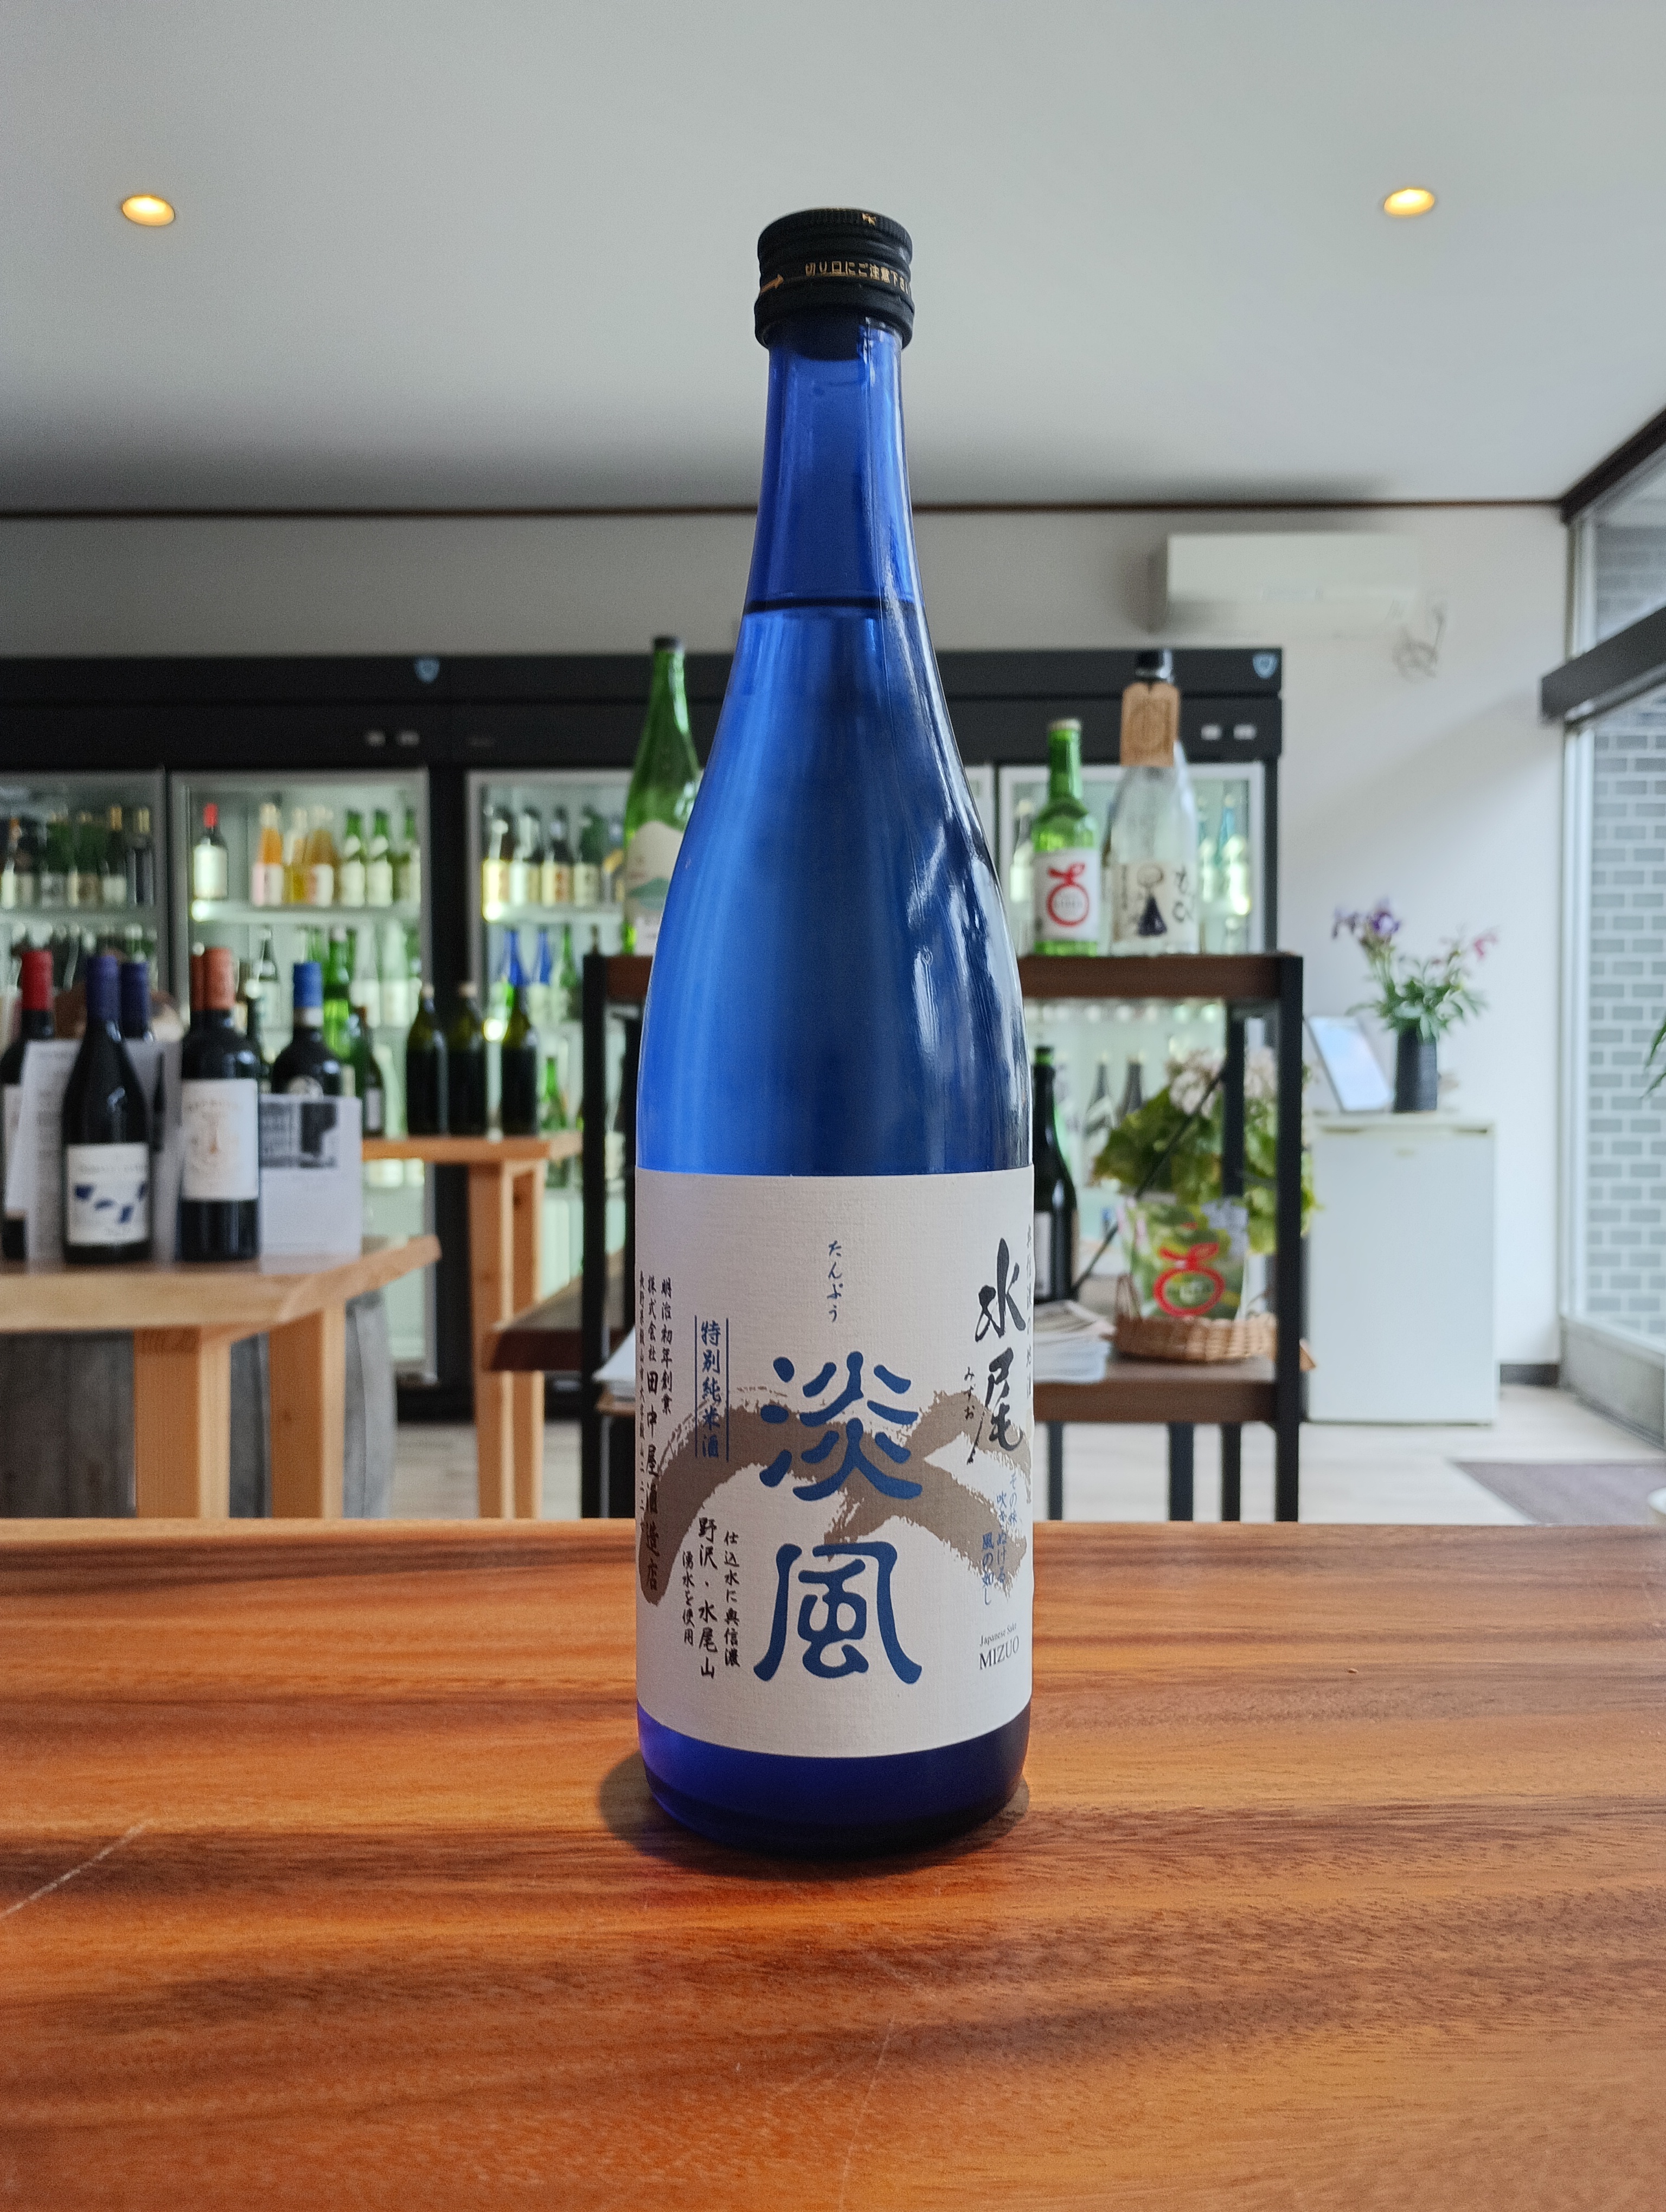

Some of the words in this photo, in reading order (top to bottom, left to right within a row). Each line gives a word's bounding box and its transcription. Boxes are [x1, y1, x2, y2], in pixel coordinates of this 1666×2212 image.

[701, 1320, 721, 1458] 特別純米酒
[966, 1238, 1026, 1464] 水尾
[753, 1351, 922, 1684] 淡風
[979, 1629, 1006, 1647] Japanese
[979, 1635, 1019, 1670] MIZUO
